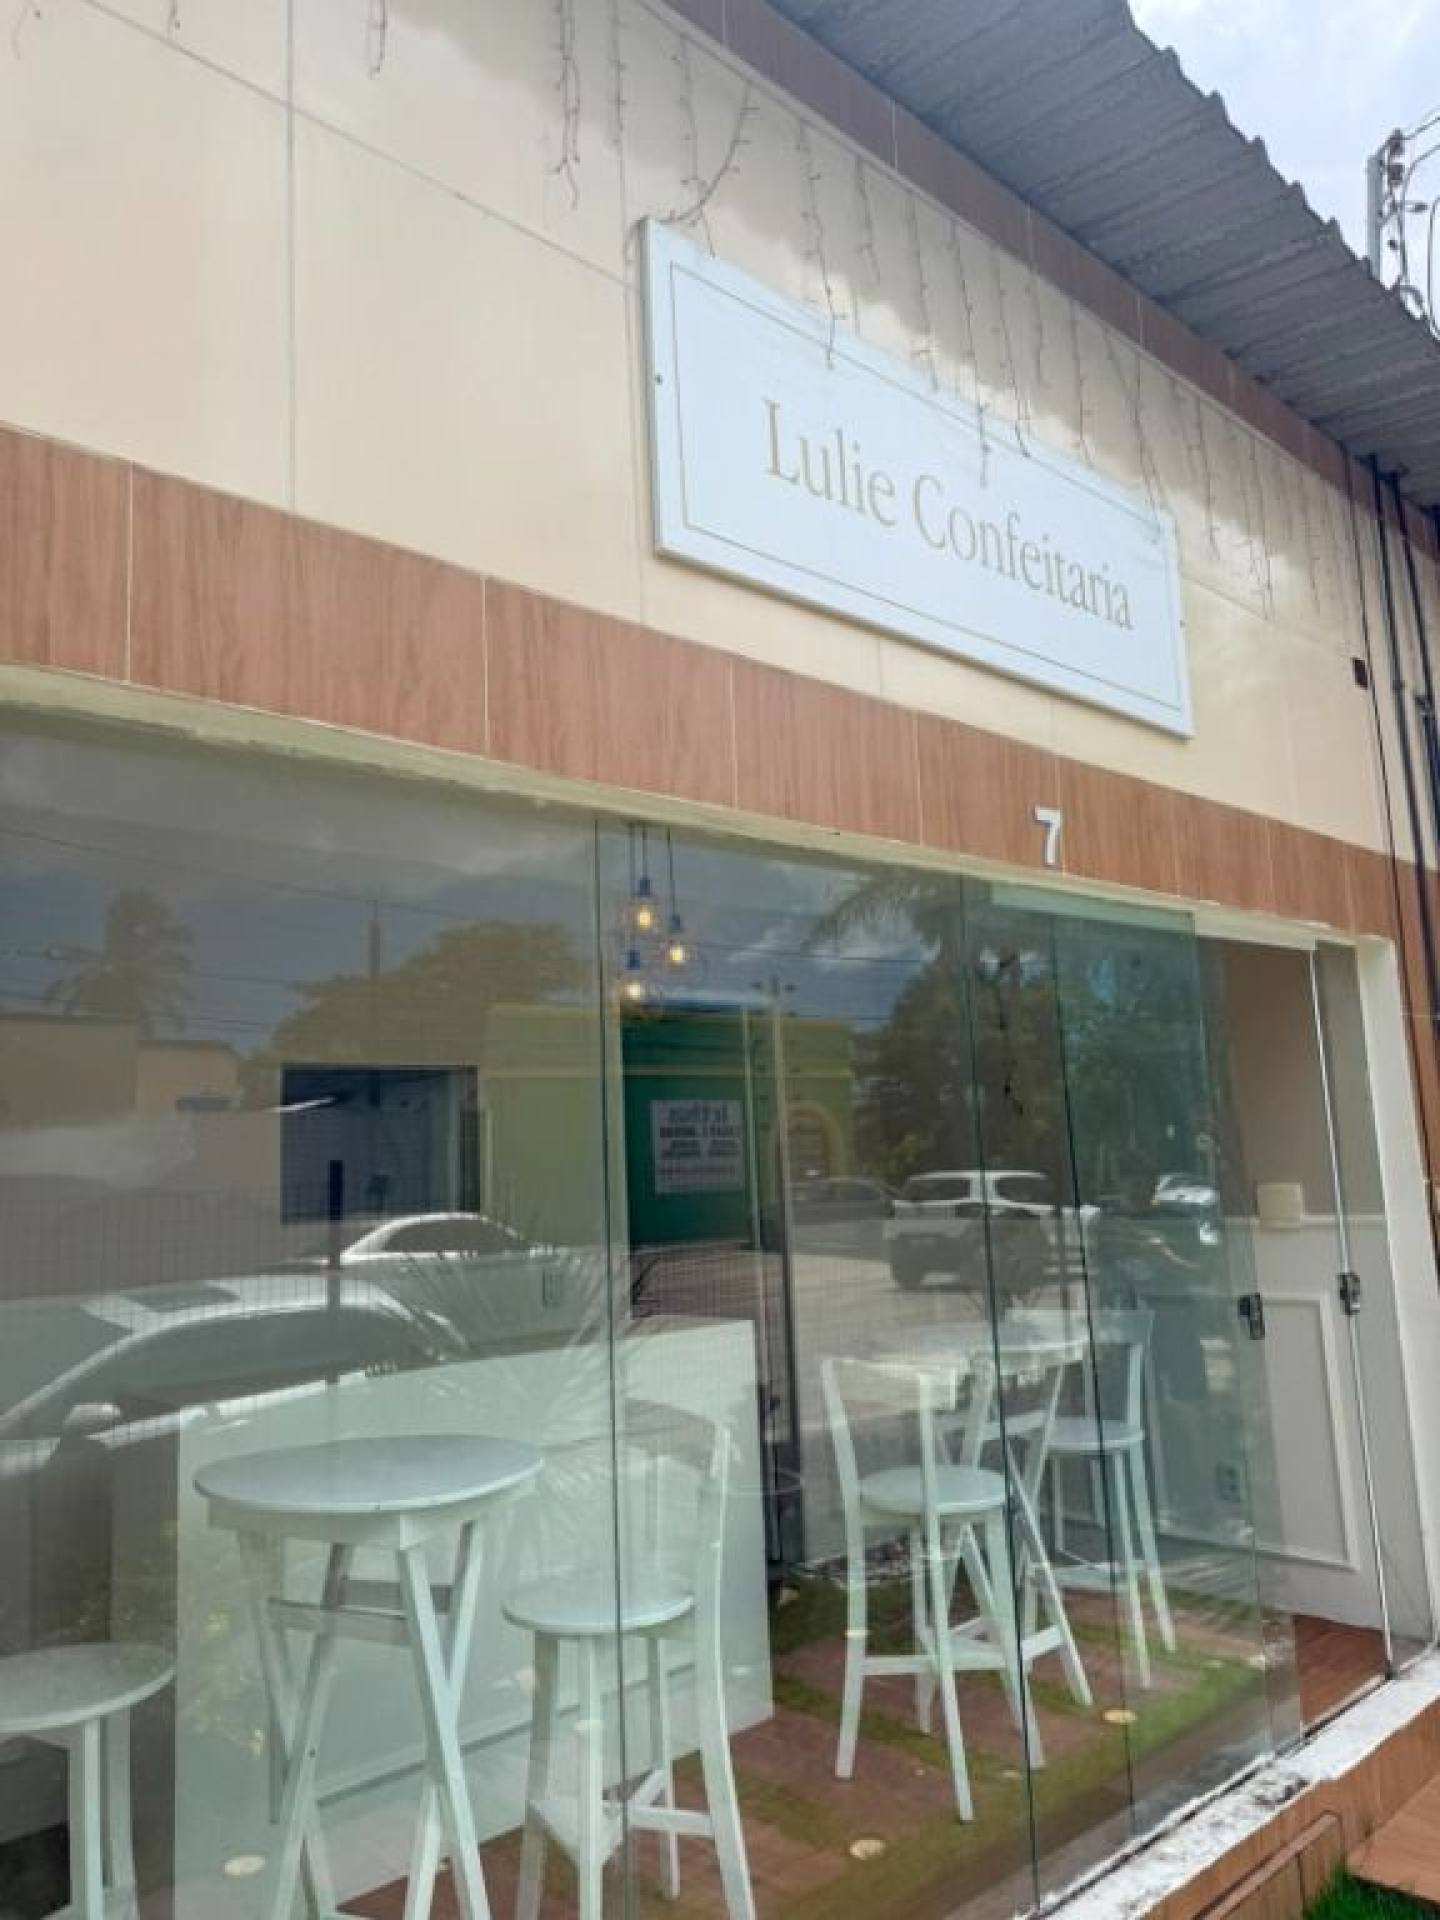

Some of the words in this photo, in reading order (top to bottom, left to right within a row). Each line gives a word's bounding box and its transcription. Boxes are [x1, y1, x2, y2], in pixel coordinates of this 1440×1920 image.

[764, 399, 897, 527] Lulie
[911, 473, 1135, 632] Confeitaria
[1034, 807, 1062, 865] 7
